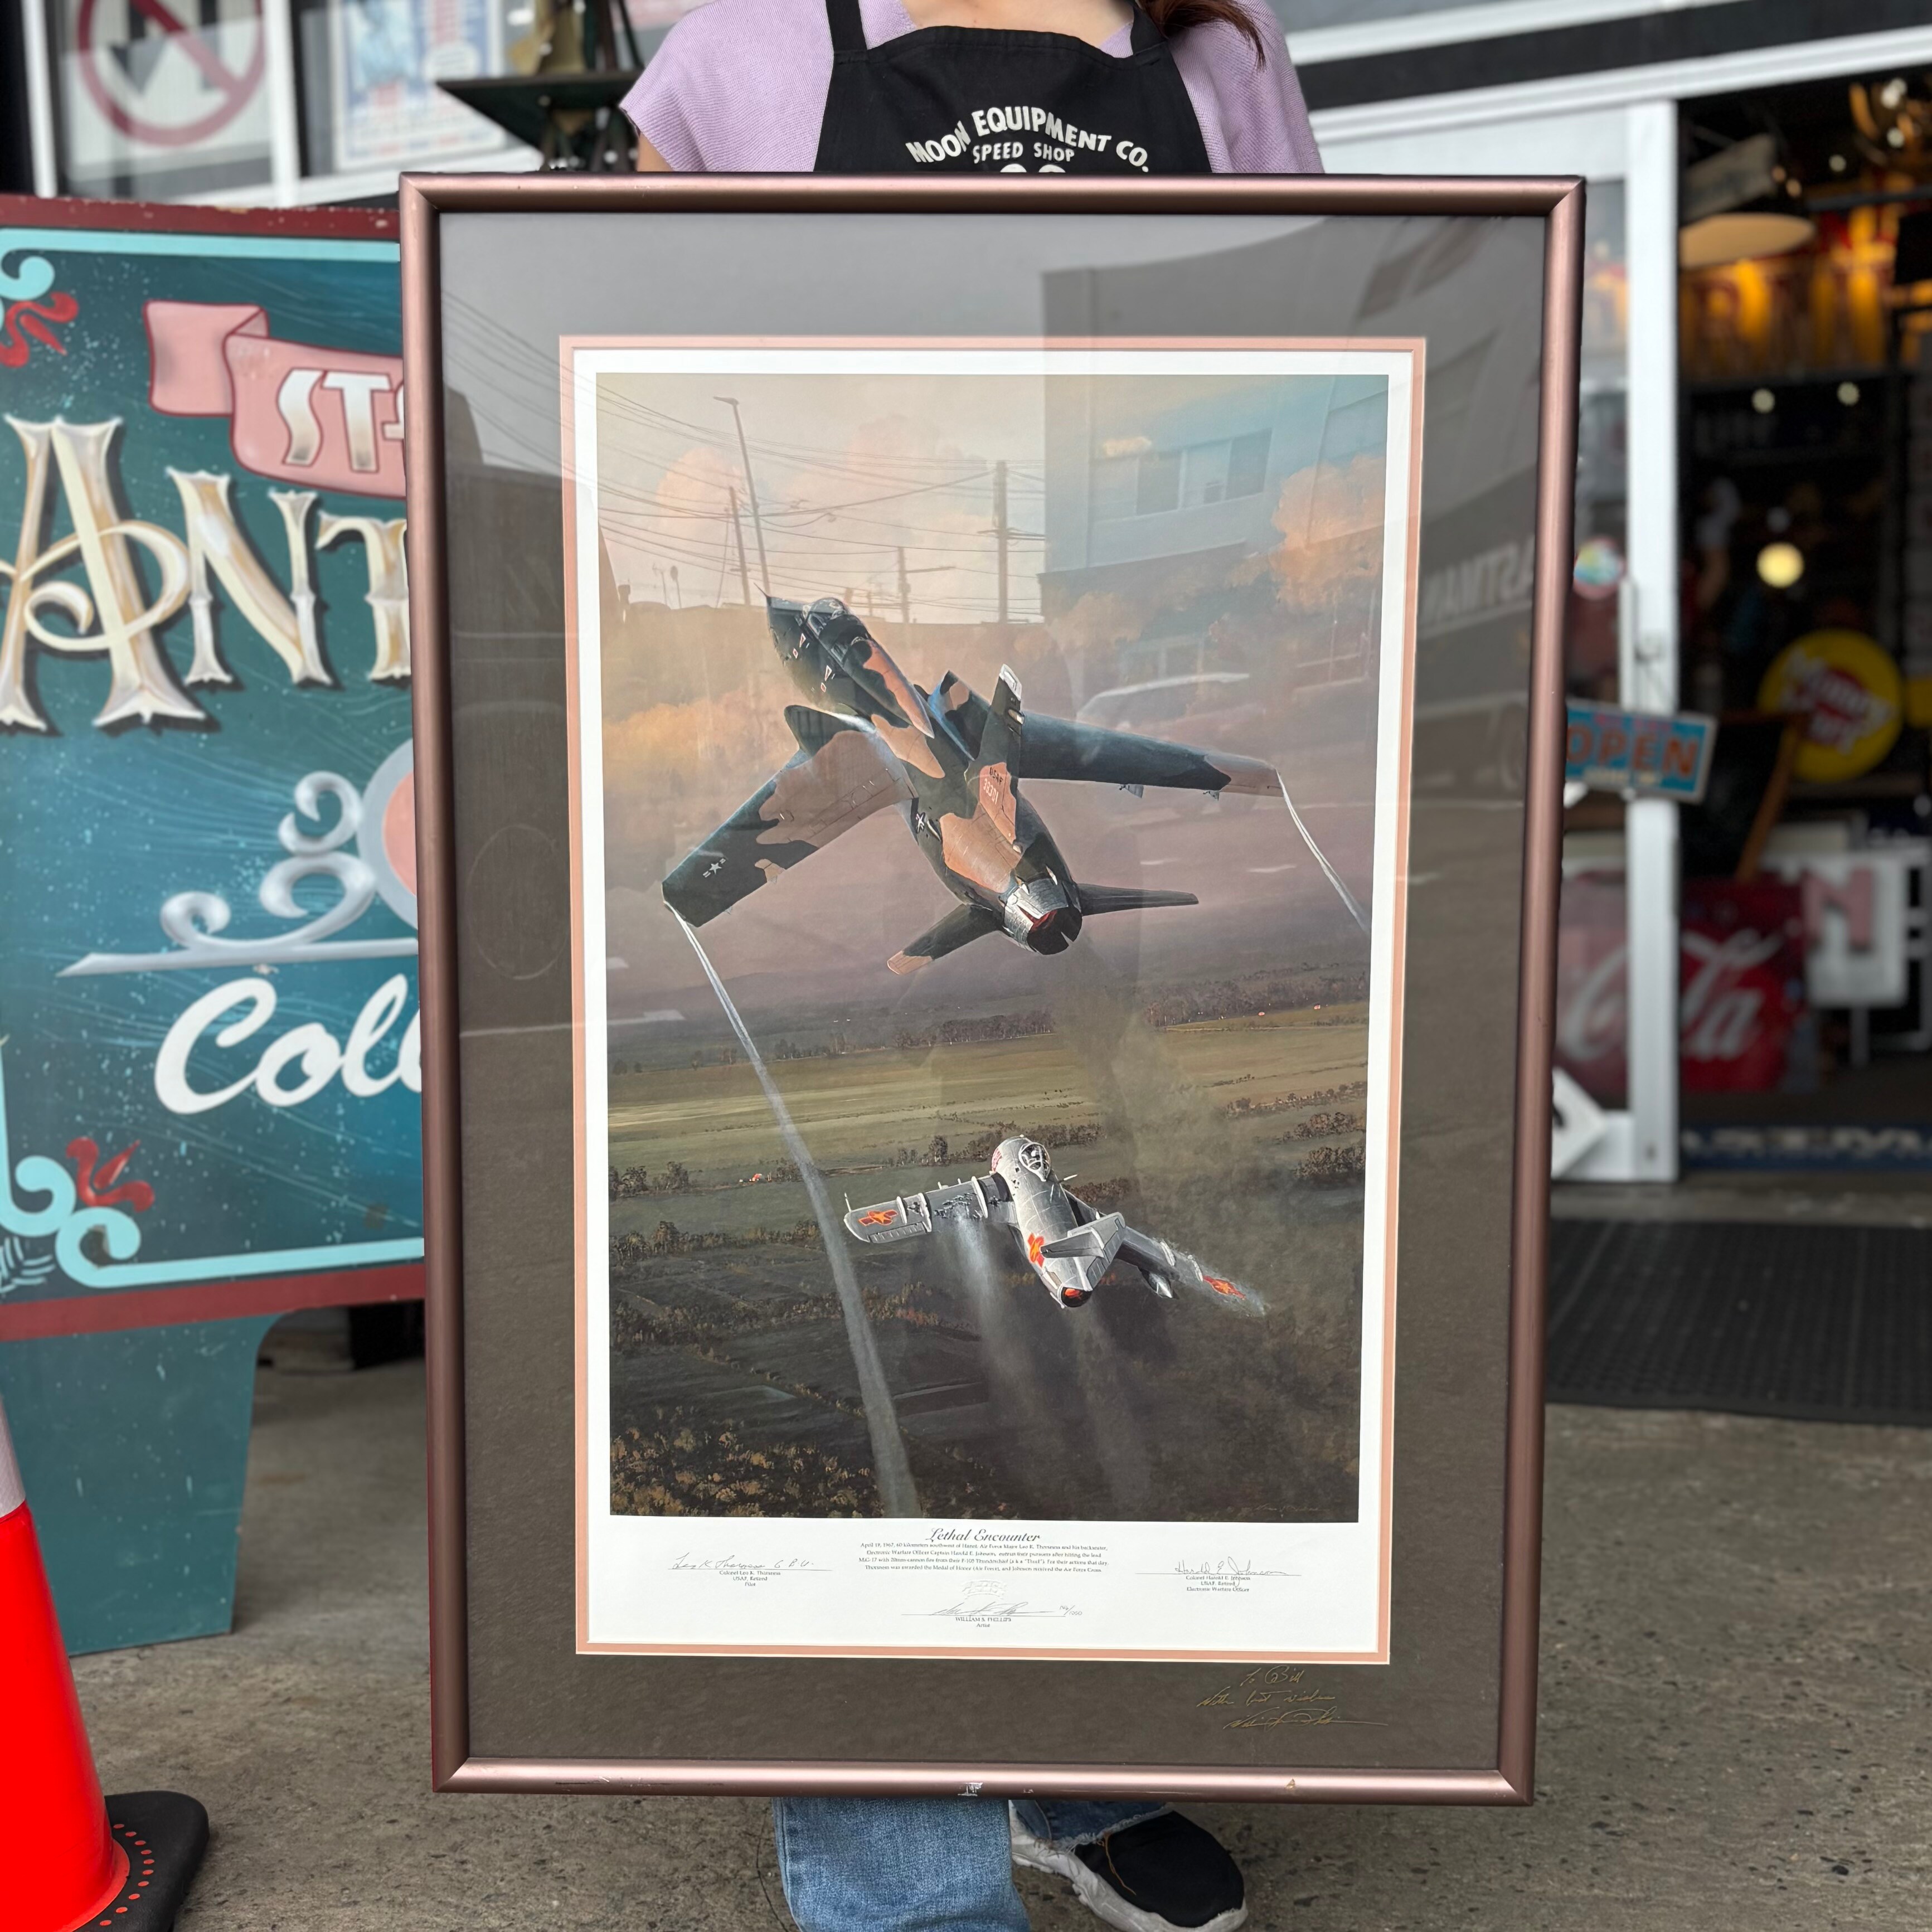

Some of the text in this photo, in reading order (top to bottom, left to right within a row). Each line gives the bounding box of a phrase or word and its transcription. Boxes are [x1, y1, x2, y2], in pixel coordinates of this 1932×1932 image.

[906, 106, 1148, 172] MOON EQUIPMENT CO.
[972, 142, 1075, 164] SPEED SHOP
[1565, 725, 1698, 777] OPEN
[989, 767, 1003, 785] USAF
[925, 1528, 1041, 1542] Lethal Encounter
